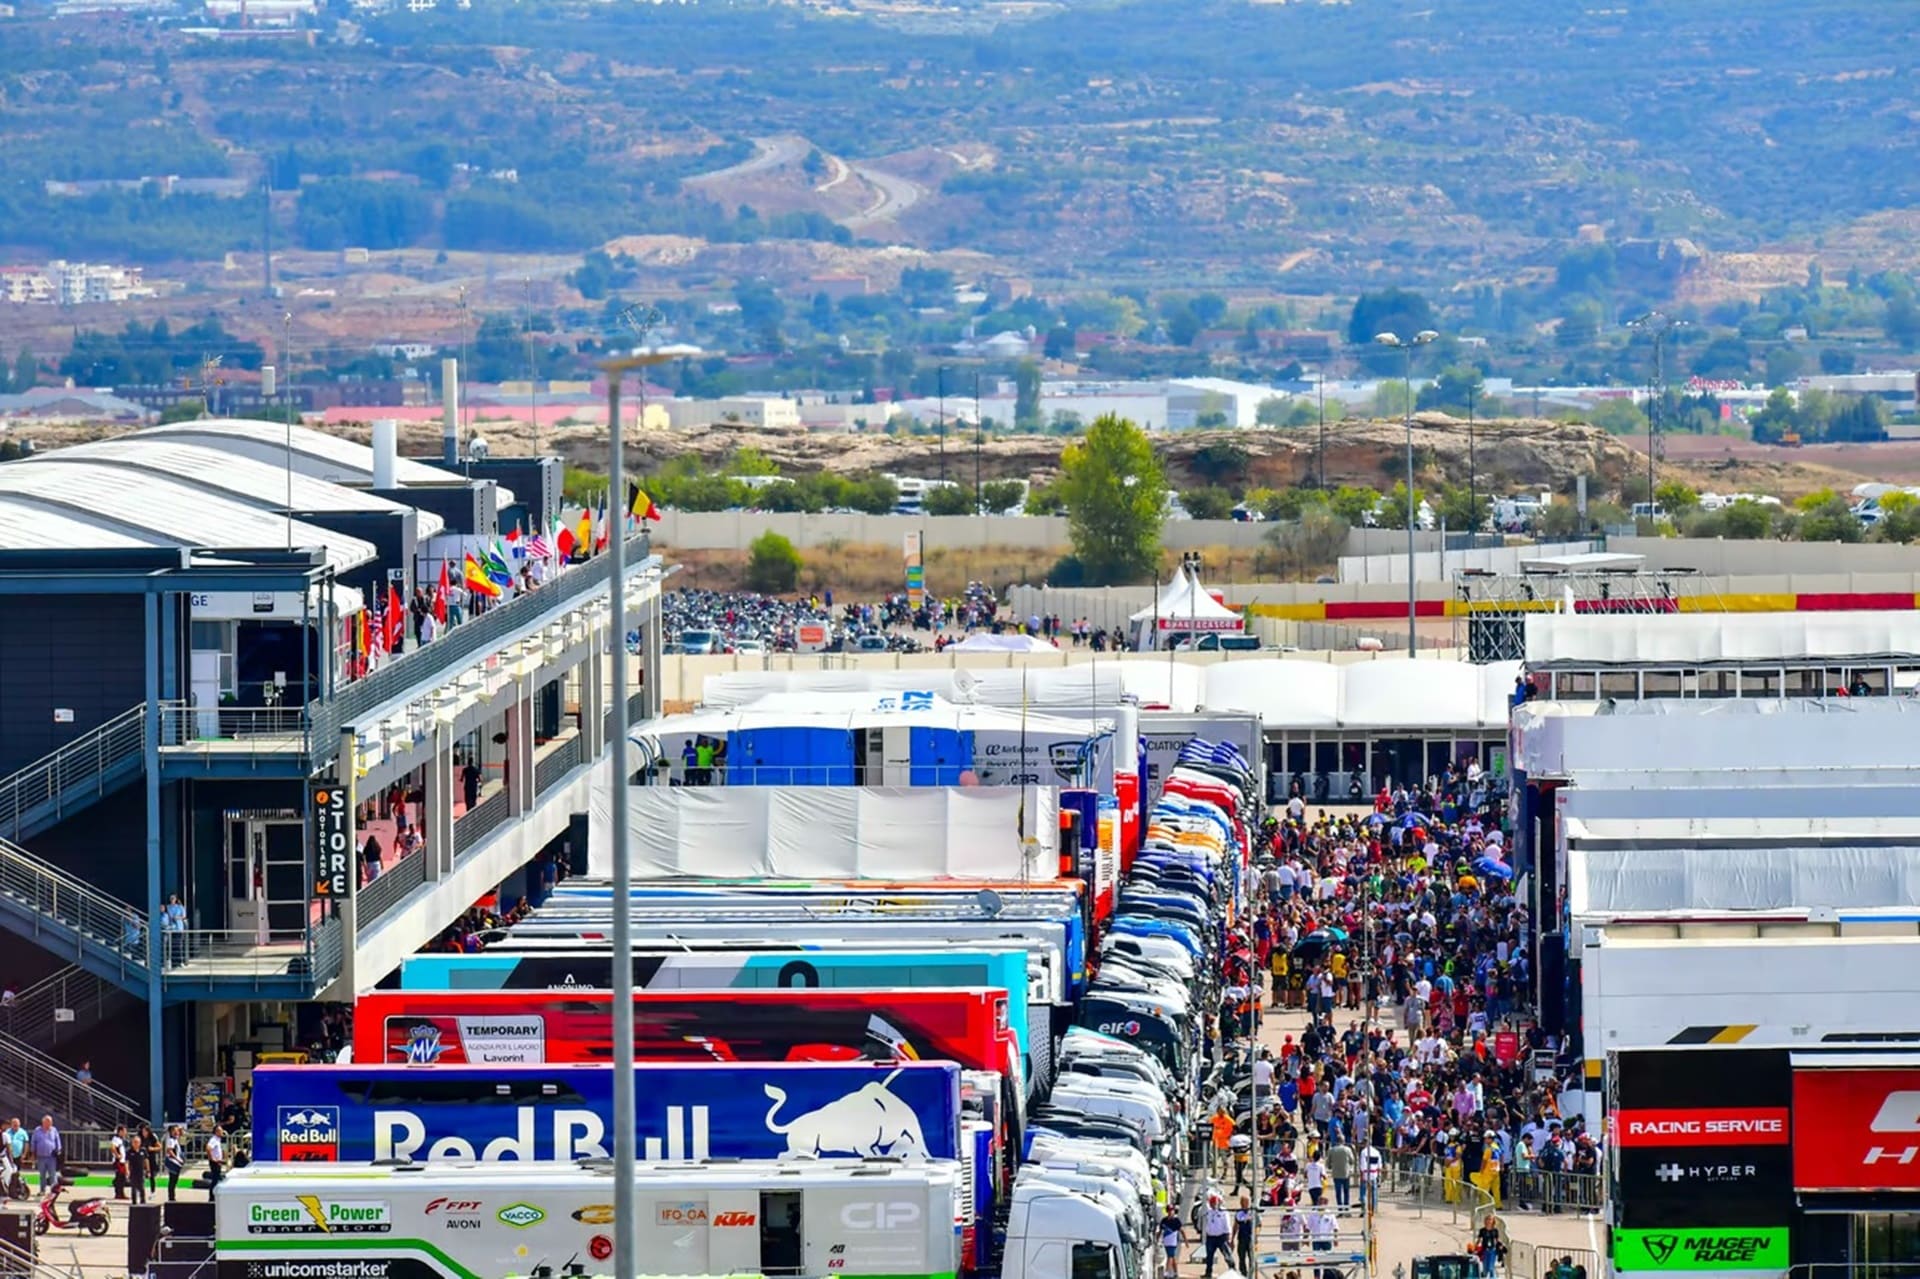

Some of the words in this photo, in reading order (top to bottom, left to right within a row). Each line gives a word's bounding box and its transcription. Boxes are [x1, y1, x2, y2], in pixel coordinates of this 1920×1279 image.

[318, 807, 328, 877] MOTORLAND
[330, 789, 346, 894] STORE
[466, 1026, 539, 1036] TEMPORARY
[554, 1106, 709, 1161] Bll
[1630, 1121, 1700, 1134] RACING
[1705, 1119, 1782, 1133] SERVICE
[281, 1128, 308, 1142] Red
[310, 1128, 336, 1142] Bull
[1689, 1165, 1756, 1176] HYPER
[252, 1205, 300, 1221] Green
[330, 1204, 383, 1220] Power
[446, 1201, 482, 1210] FPT
[713, 1211, 756, 1226] KTM
[840, 1202, 920, 1229] CIP
[446, 1220, 481, 1229] AVONI
[1684, 1237, 1771, 1250] MUGEN
[1694, 1250, 1756, 1261] RACE
[264, 1260, 388, 1277] unicomstarker
